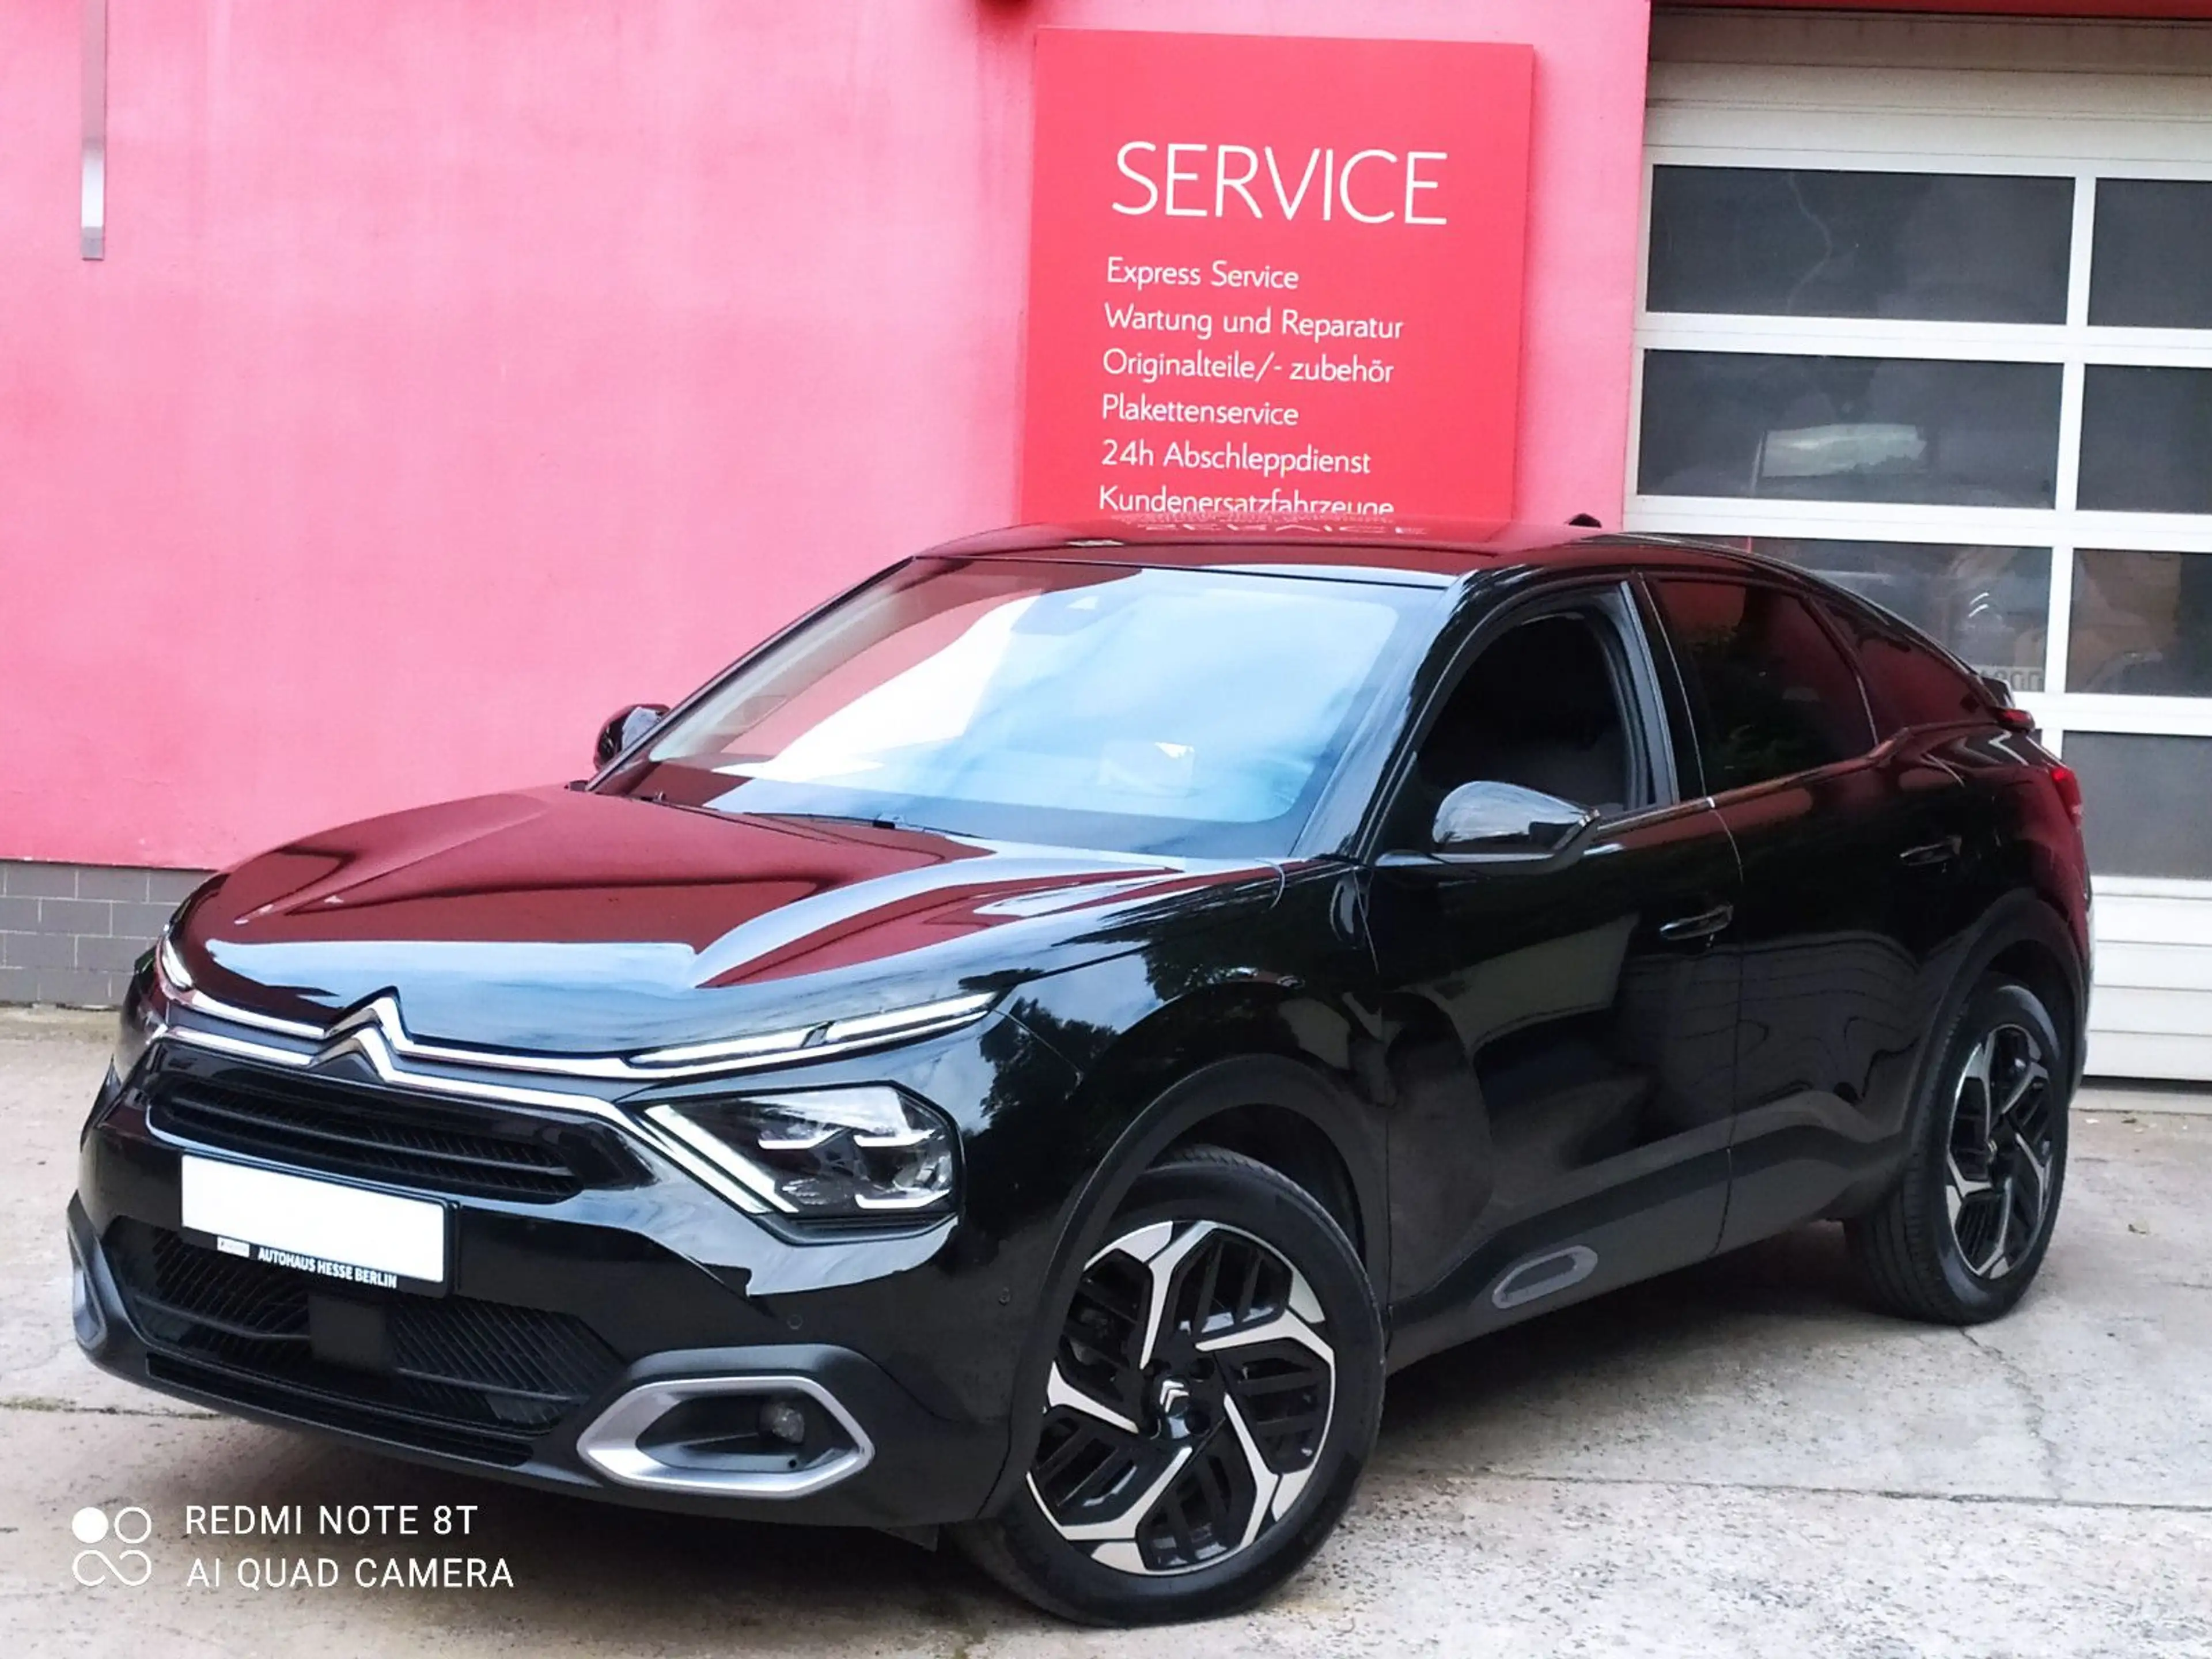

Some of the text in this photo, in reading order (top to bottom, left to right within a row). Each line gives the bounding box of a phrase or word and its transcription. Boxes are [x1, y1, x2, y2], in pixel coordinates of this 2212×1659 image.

[1112, 141, 1448, 225] SERVICE
[1107, 256, 1299, 291] Express Service
[1104, 302, 1403, 343] Wartung und Reparatur
[1290, 354, 1394, 382] zubehör
[1103, 392, 1299, 425] Plakettenservice
[1101, 439, 1371, 478] 24h Abschleppdienst
[257, 1247, 316, 1272] AUTOHAUS
[317, 1259, 353, 1280] HESSE
[354, 1267, 397, 1289] BERLIN
